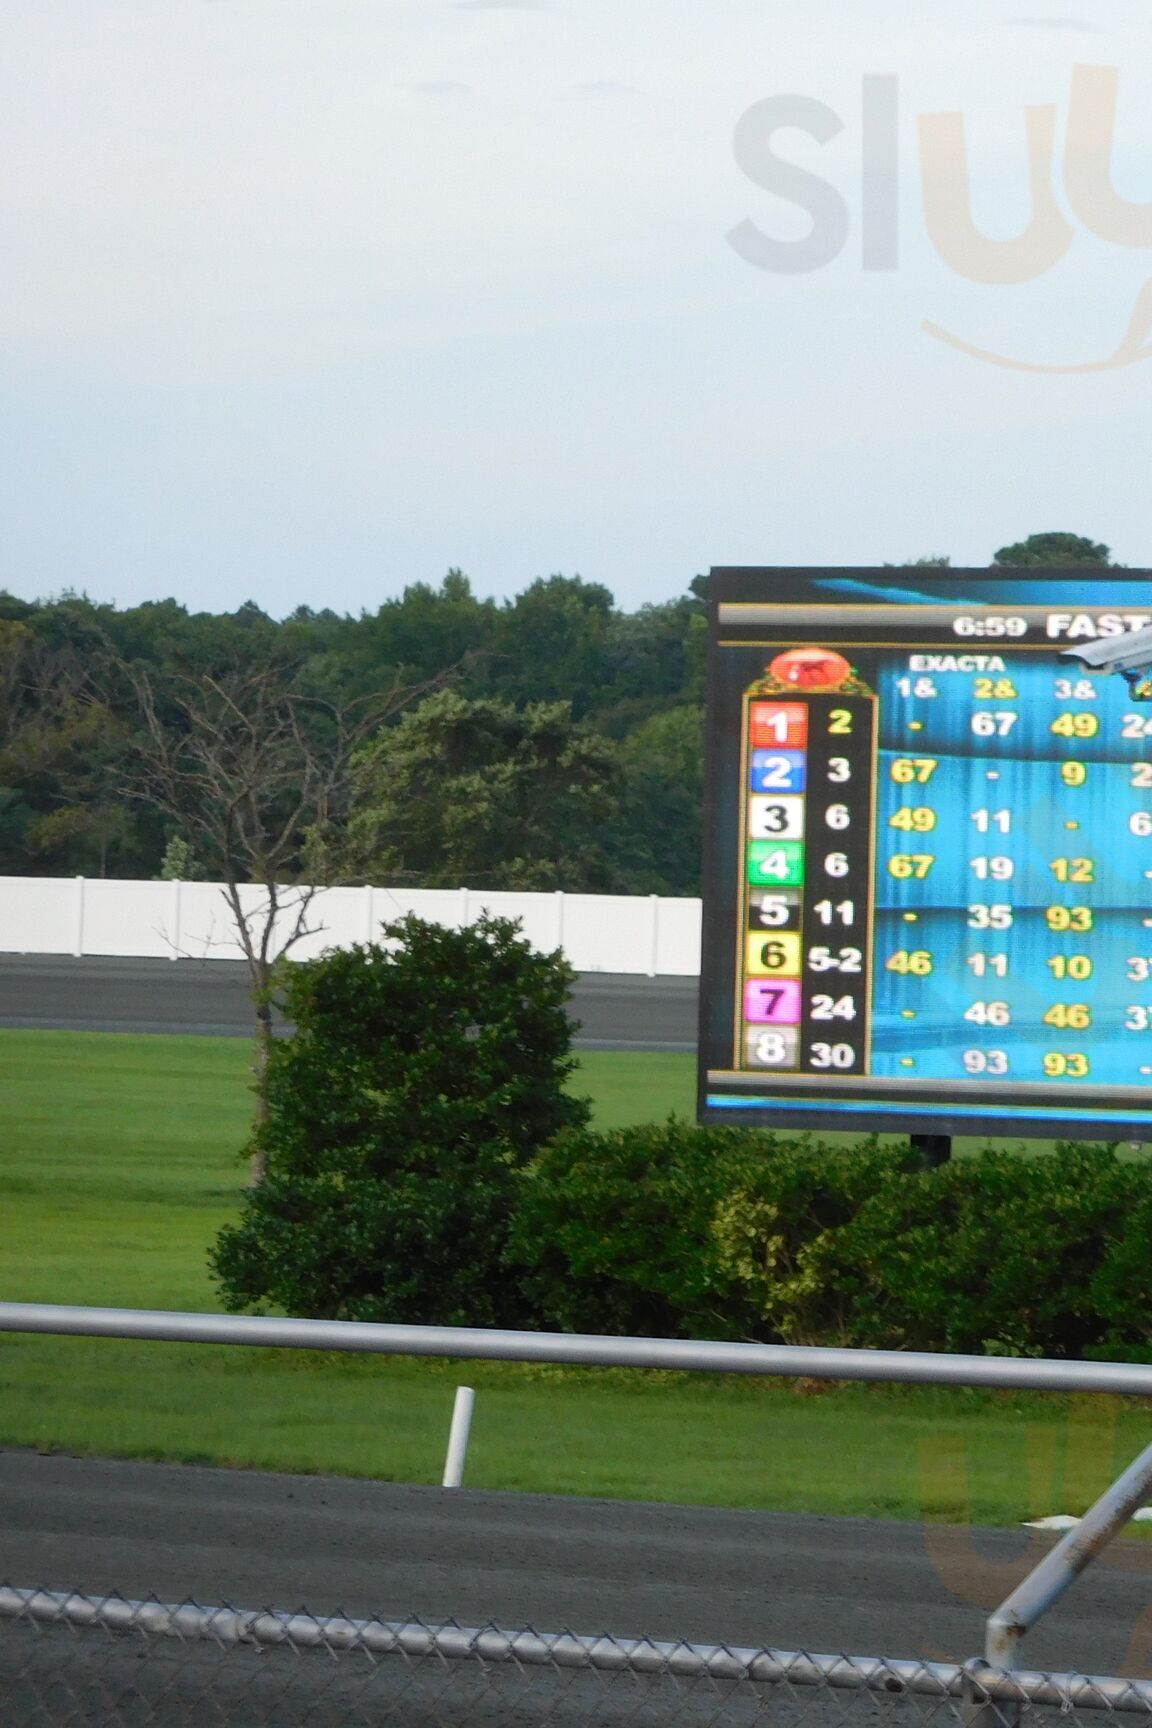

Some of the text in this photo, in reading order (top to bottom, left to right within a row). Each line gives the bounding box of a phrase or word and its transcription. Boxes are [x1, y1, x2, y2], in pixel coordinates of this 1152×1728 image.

[952, 614, 1151, 638] 6:59 FAST
[908, 654, 1007, 673] EXACTA
[767, 709, 853, 744] 1 2
[971, 711, 1018, 737] 67
[1050, 712, 1098, 738] 49
[762, 757, 851, 787] 2 3
[890, 758, 938, 783] 67
[1060, 761, 1087, 786] 9
[763, 803, 850, 834] 3 6
[889, 807, 937, 833] 49
[970, 808, 1012, 835] 11
[761, 850, 849, 879] 4 6
[888, 854, 935, 879] 67
[969, 855, 1015, 881] 19
[1049, 857, 1094, 883] 12
[760, 896, 854, 926] 5 11
[966, 904, 1014, 930] 35
[1046, 905, 1093, 932] 93
[760, 941, 863, 973] 6 5-2
[885, 949, 933, 976] 46
[966, 952, 1008, 978] 11
[1047, 954, 1093, 980] 10
[759, 988, 857, 1021] 7 24
[963, 1000, 1011, 1027] 46
[1042, 1003, 1091, 1029] 46
[757, 1033, 856, 1068] 8 30
[963, 1049, 1008, 1076] 93
[1043, 1052, 1090, 1078] 93
